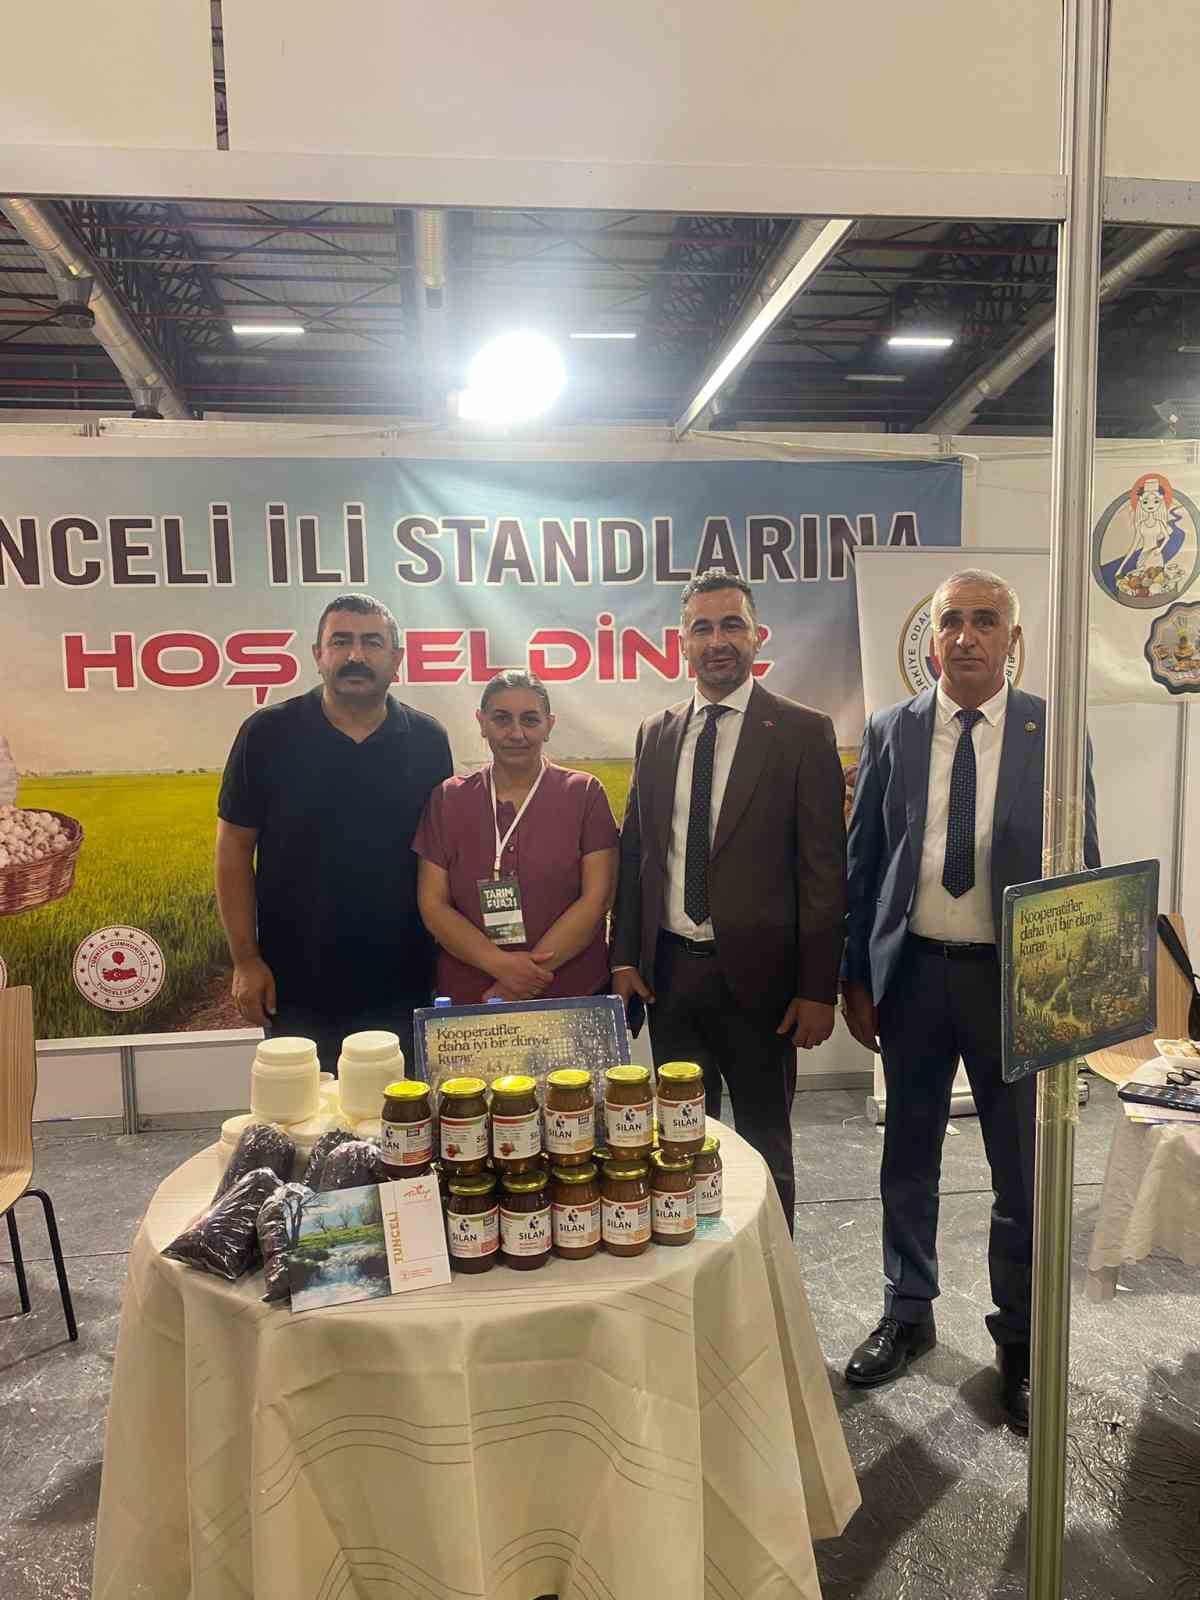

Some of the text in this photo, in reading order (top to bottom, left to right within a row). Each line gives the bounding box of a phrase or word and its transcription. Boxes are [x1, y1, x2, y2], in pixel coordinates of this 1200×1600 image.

[268, 503, 365, 585] İLİ
[63, 630, 298, 706] HOŞ
[483, 887, 514, 900] TARIM
[437, 1023, 521, 1041] Kooperatifler
[438, 1040, 470, 1052] daha
[490, 1036, 508, 1048] bir
